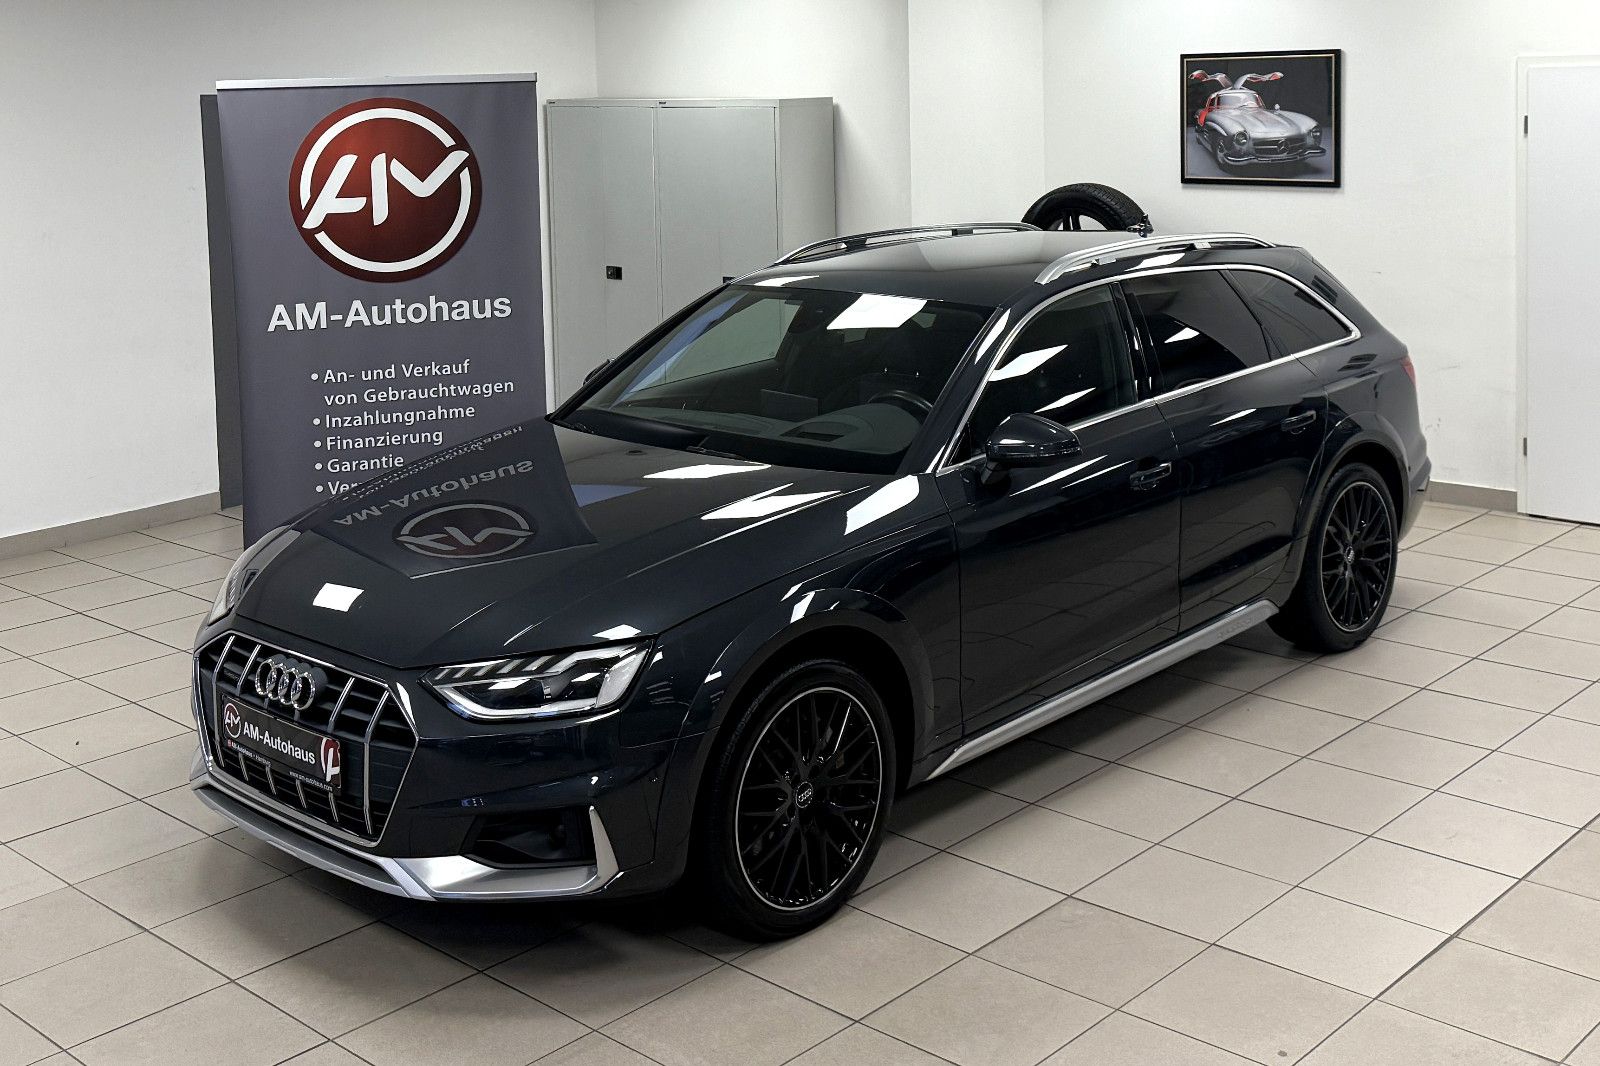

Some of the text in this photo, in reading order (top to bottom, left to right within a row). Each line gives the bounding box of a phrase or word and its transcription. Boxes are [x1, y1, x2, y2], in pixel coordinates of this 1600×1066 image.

[266, 295, 512, 332] AM-Autohaus
[323, 358, 470, 384] An- und Verkauf
[323, 380, 514, 406] von Gebrauchtwagen
[325, 405, 476, 429] Inzahlungnahme
[326, 430, 444, 451] Finanzierung
[327, 453, 405, 474] Garantie
[327, 481, 362, 495] Ver
[243, 720, 316, 765] AM-Autohaus
